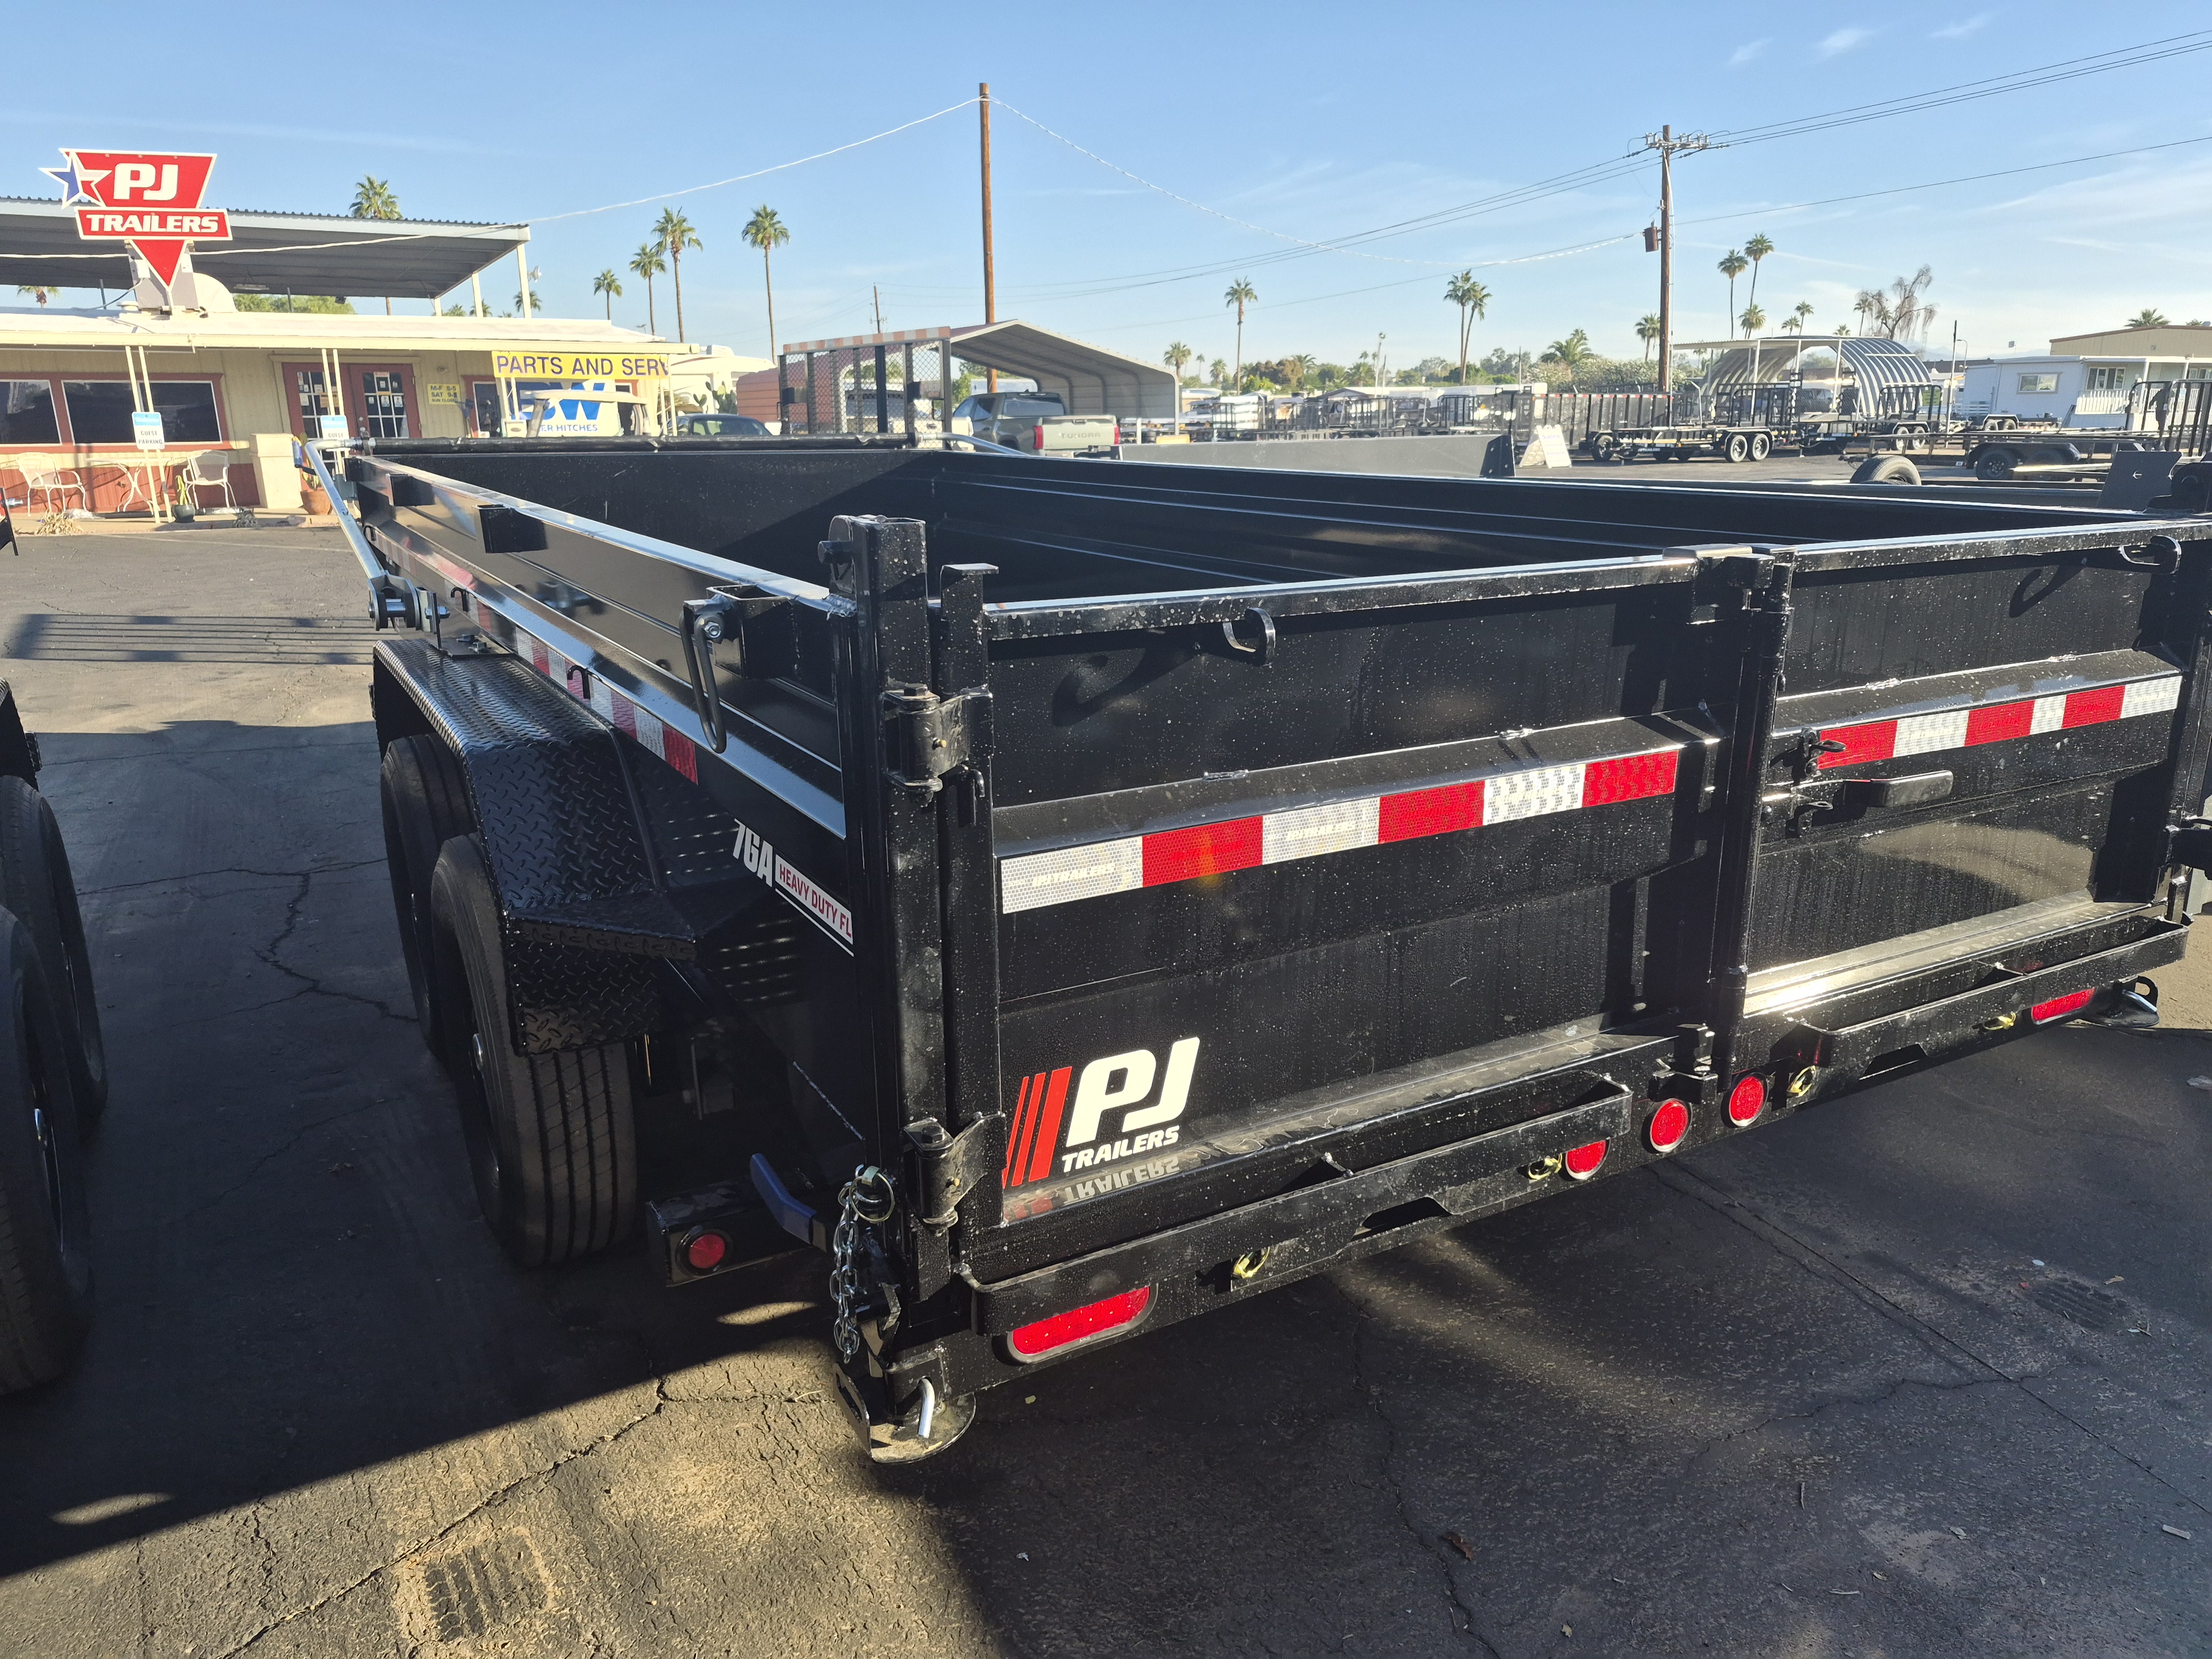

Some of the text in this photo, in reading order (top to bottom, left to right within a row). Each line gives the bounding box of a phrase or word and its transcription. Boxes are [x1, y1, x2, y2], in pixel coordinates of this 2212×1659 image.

[113, 163, 178, 201] PJ
[86, 215, 218, 233] TRAILERS
[497, 356, 563, 375] PARTS
[571, 358, 613, 375] AND
[732, 818, 773, 888] 7GA
[780, 863, 852, 938] HEAVY DUTY FL
[1066, 1037, 1200, 1147] PJ
[1062, 1125, 1180, 1172] TRAILERS
